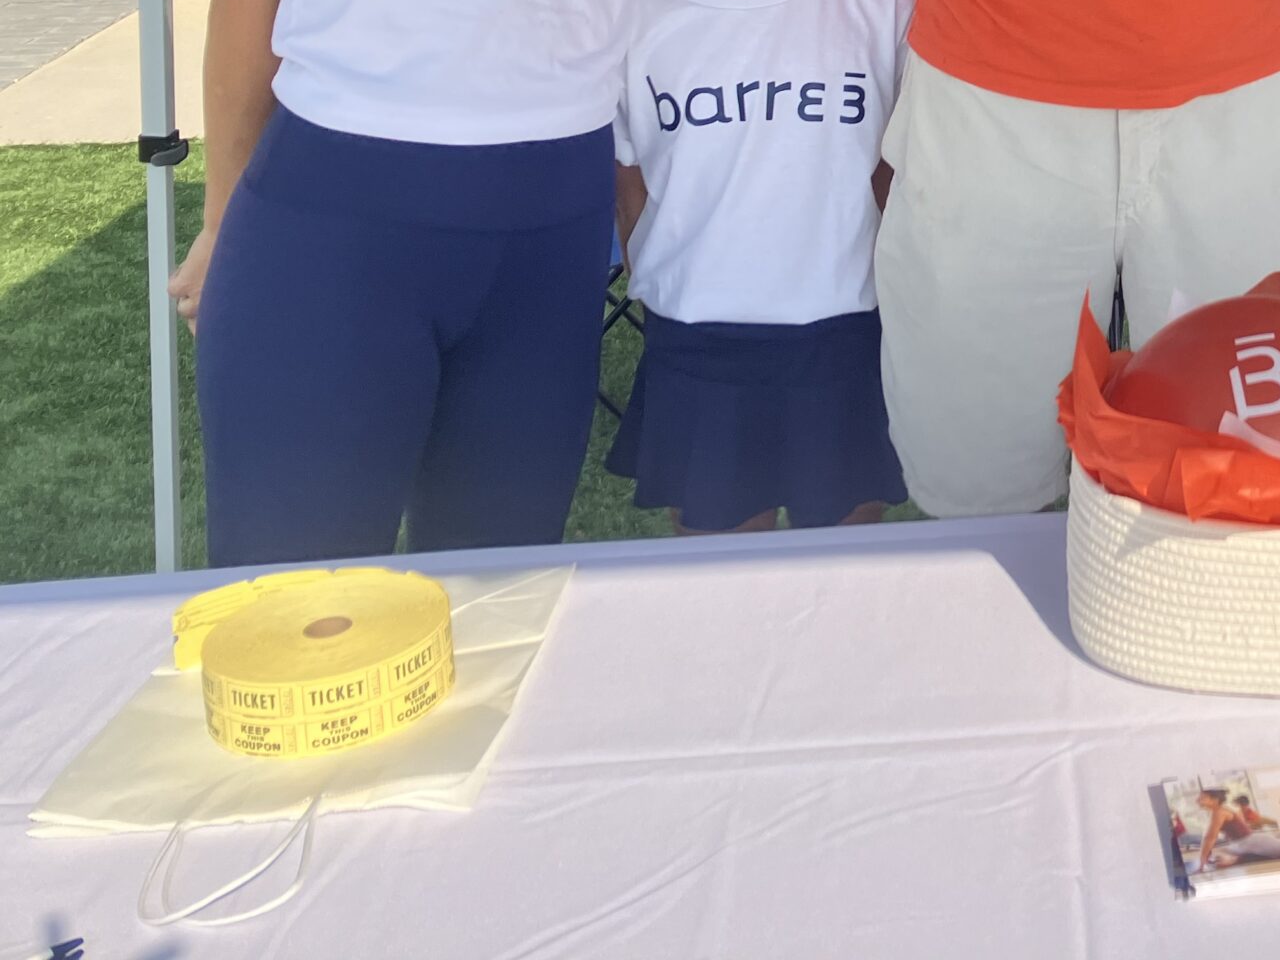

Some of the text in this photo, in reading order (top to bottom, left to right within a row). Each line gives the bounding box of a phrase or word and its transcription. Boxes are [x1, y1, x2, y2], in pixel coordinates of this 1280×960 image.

[393, 646, 432, 681] TICKET
[232, 690, 275, 710] TICKET
[309, 680, 364, 706] TICKET
[404, 680, 430, 704] KEEP
[397, 691, 437, 722] COUPON
[240, 723, 271, 737] KEEP
[320, 715, 358, 731] KEEP
[329, 726, 351, 736] THIS
[234, 738, 282, 752] COUPON
[311, 728, 369, 749] COUPON
